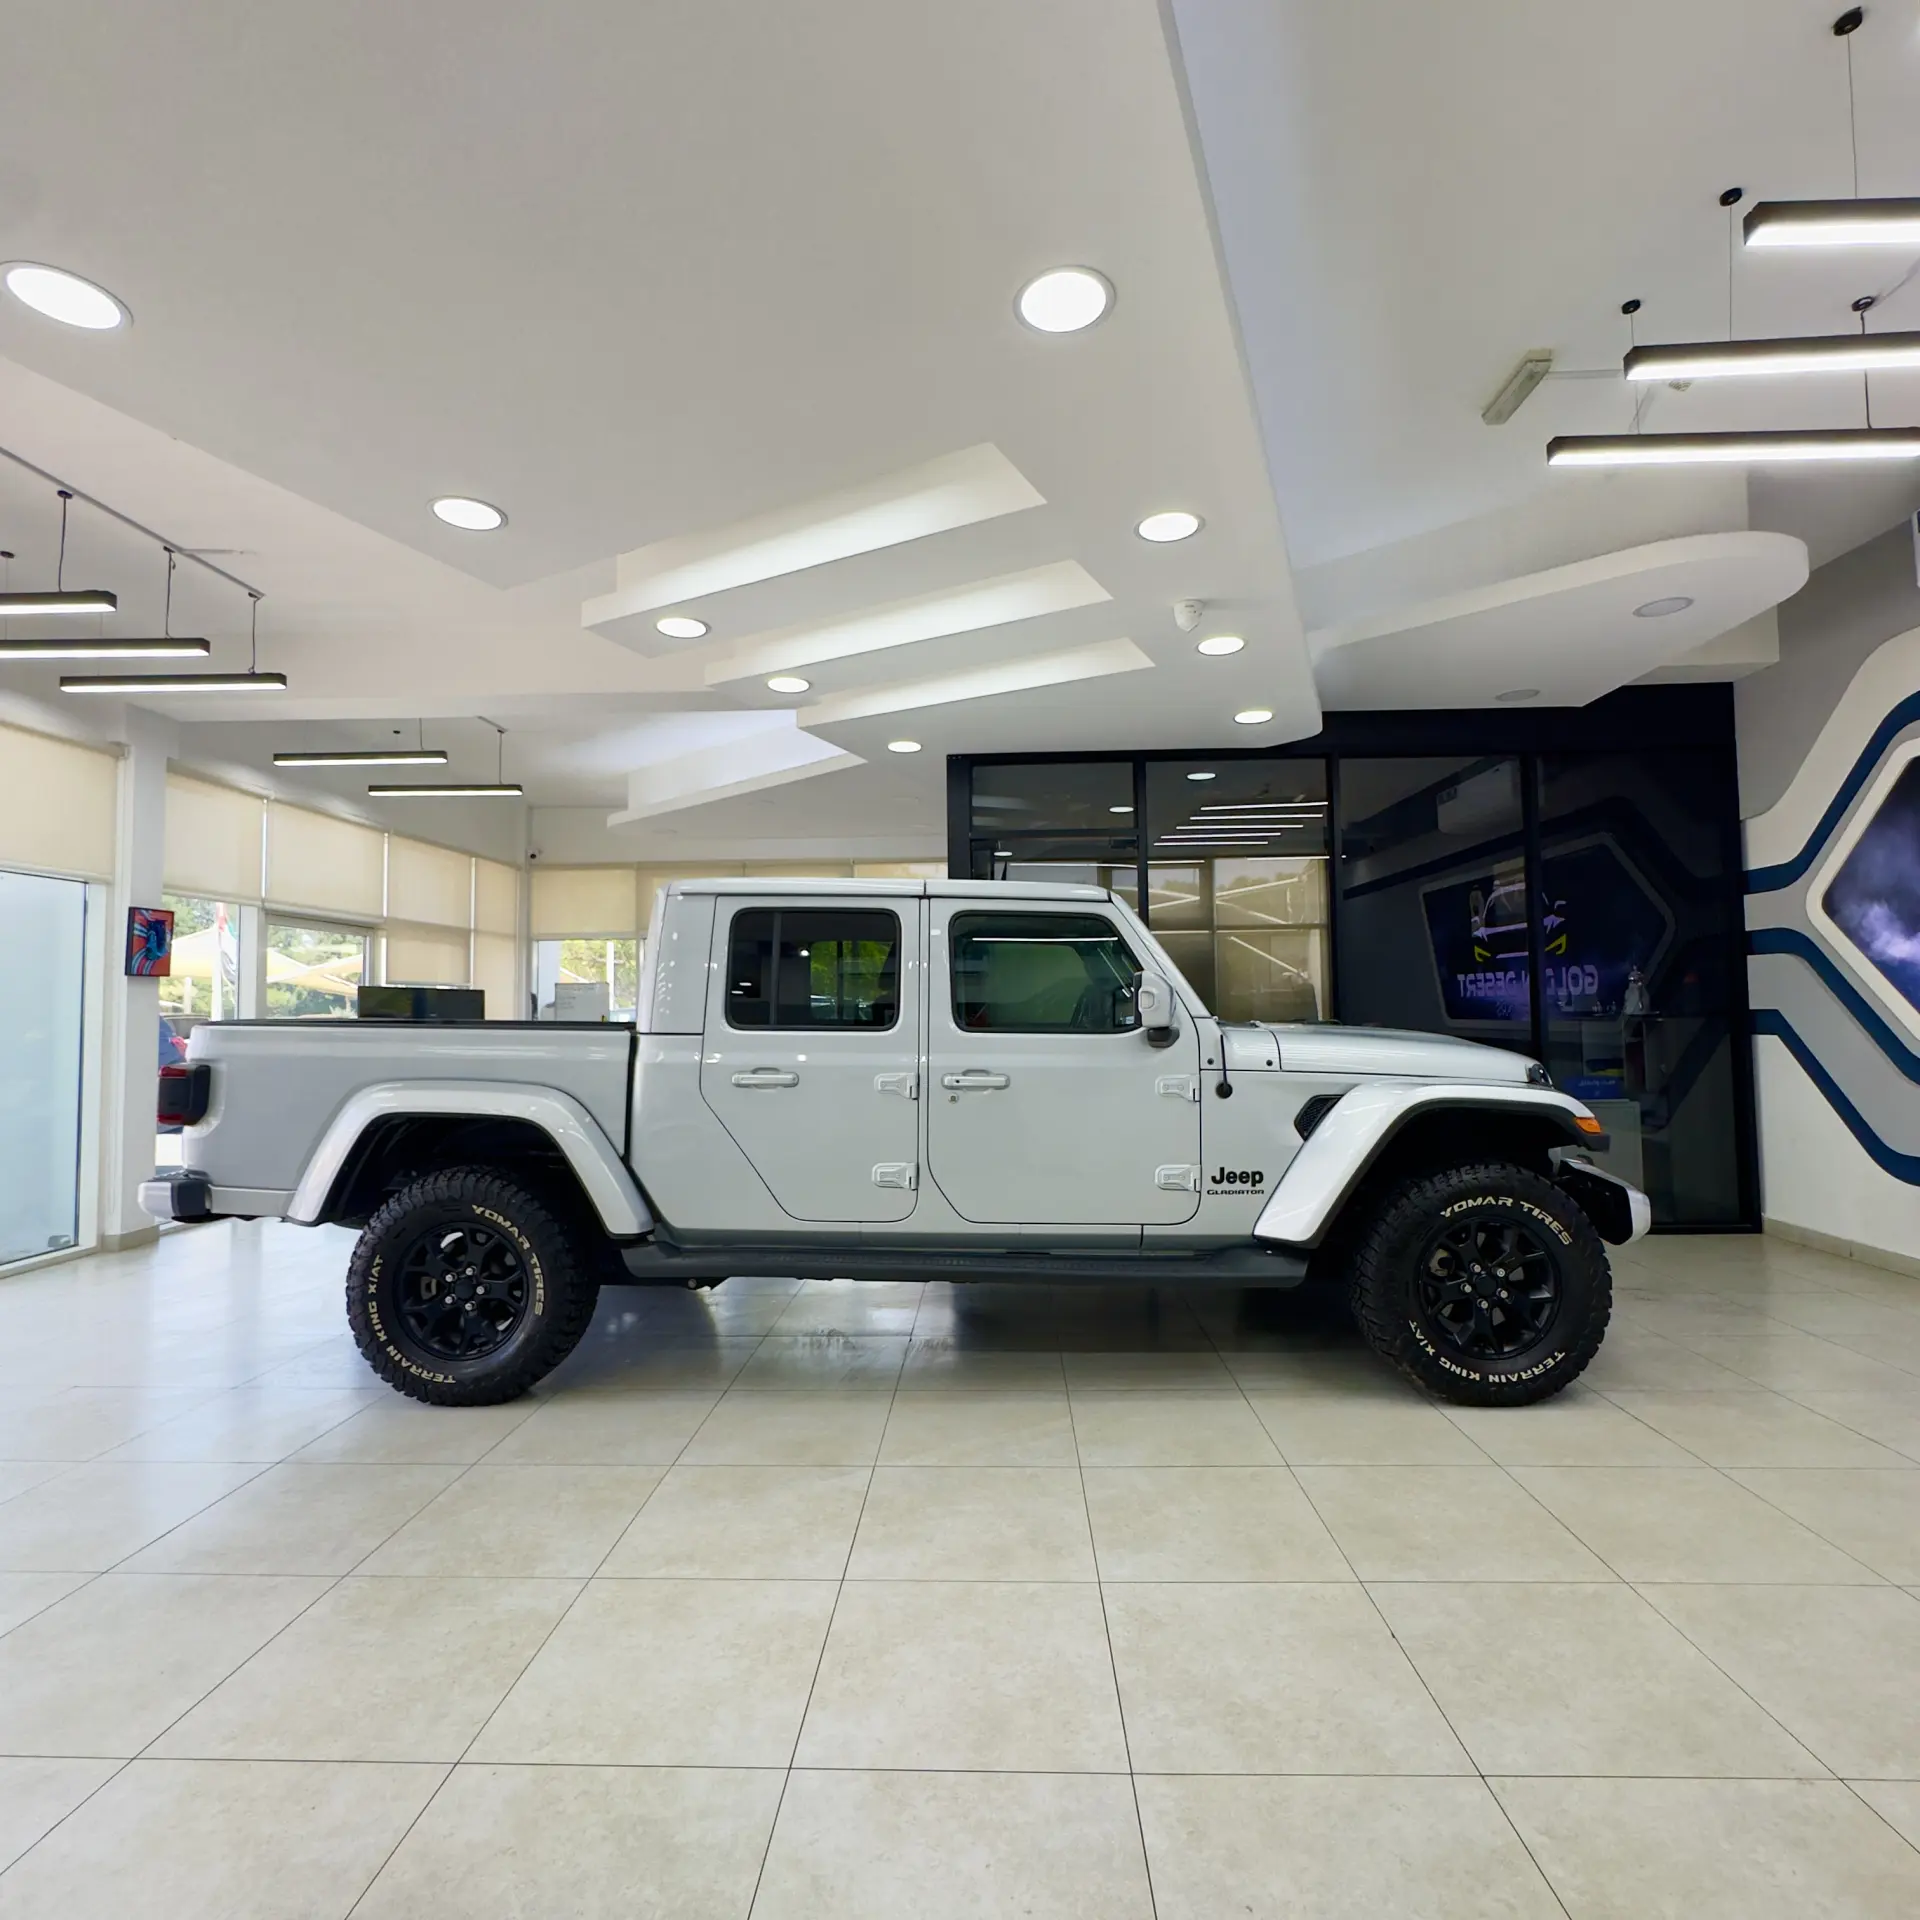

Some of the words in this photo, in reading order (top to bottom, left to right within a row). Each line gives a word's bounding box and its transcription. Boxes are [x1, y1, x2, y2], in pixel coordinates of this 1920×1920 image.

[1211, 1166, 1264, 1187] Jeep
[1440, 1196, 1514, 1218] YOMAR
[1520, 1201, 1573, 1247] TIRES
[471, 1204, 532, 1250] YOMAR
[529, 1252, 544, 1317] TIRES
[368, 1301, 388, 1342] KING
[386, 1345, 456, 1384] TERRAIN
[1438, 1356, 1481, 1381] KING
[1488, 1350, 1566, 1383] TERRAIN
